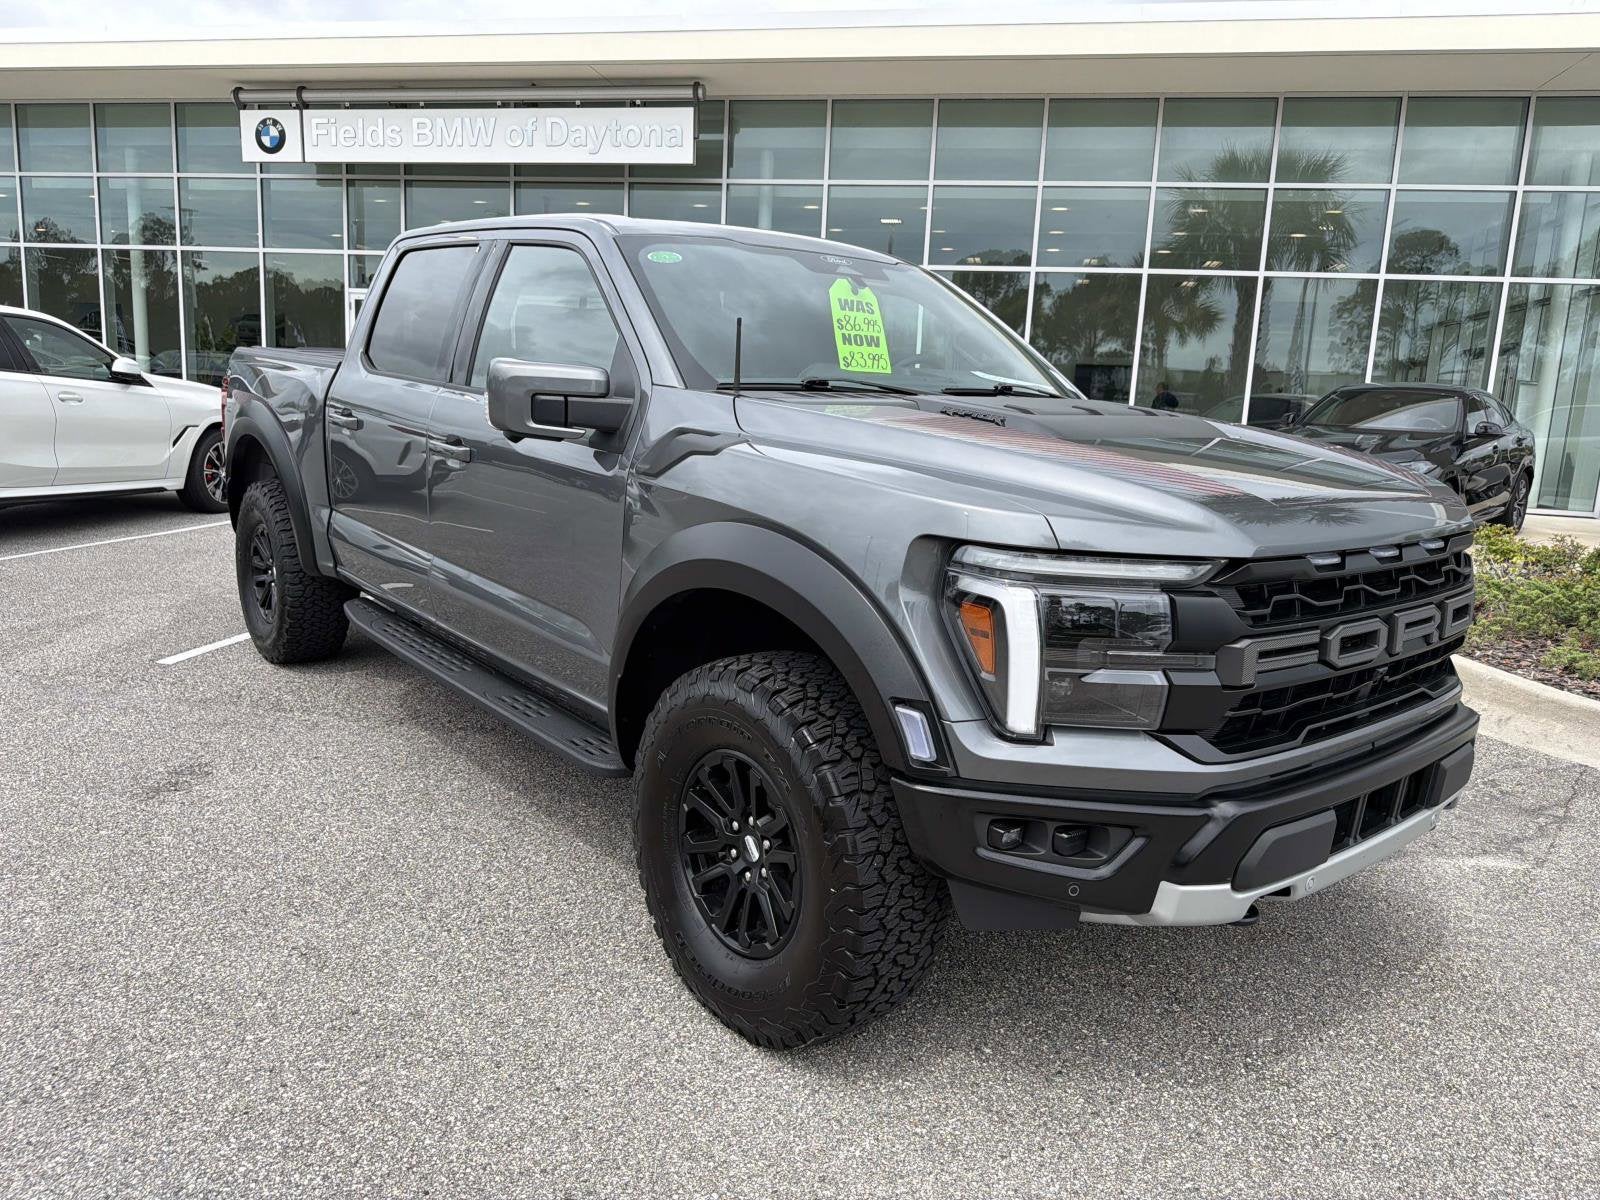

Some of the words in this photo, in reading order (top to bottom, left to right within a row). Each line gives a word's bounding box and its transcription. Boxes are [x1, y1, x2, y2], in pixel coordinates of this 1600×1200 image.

[311, 117, 402, 148] Fields
[411, 117, 497, 148] BMW
[505, 117, 537, 148] of
[545, 117, 684, 155] Daytona
[838, 298, 875, 315] WAS
[841, 333, 881, 348] NOW
[1216, 589, 1475, 688] FORD
